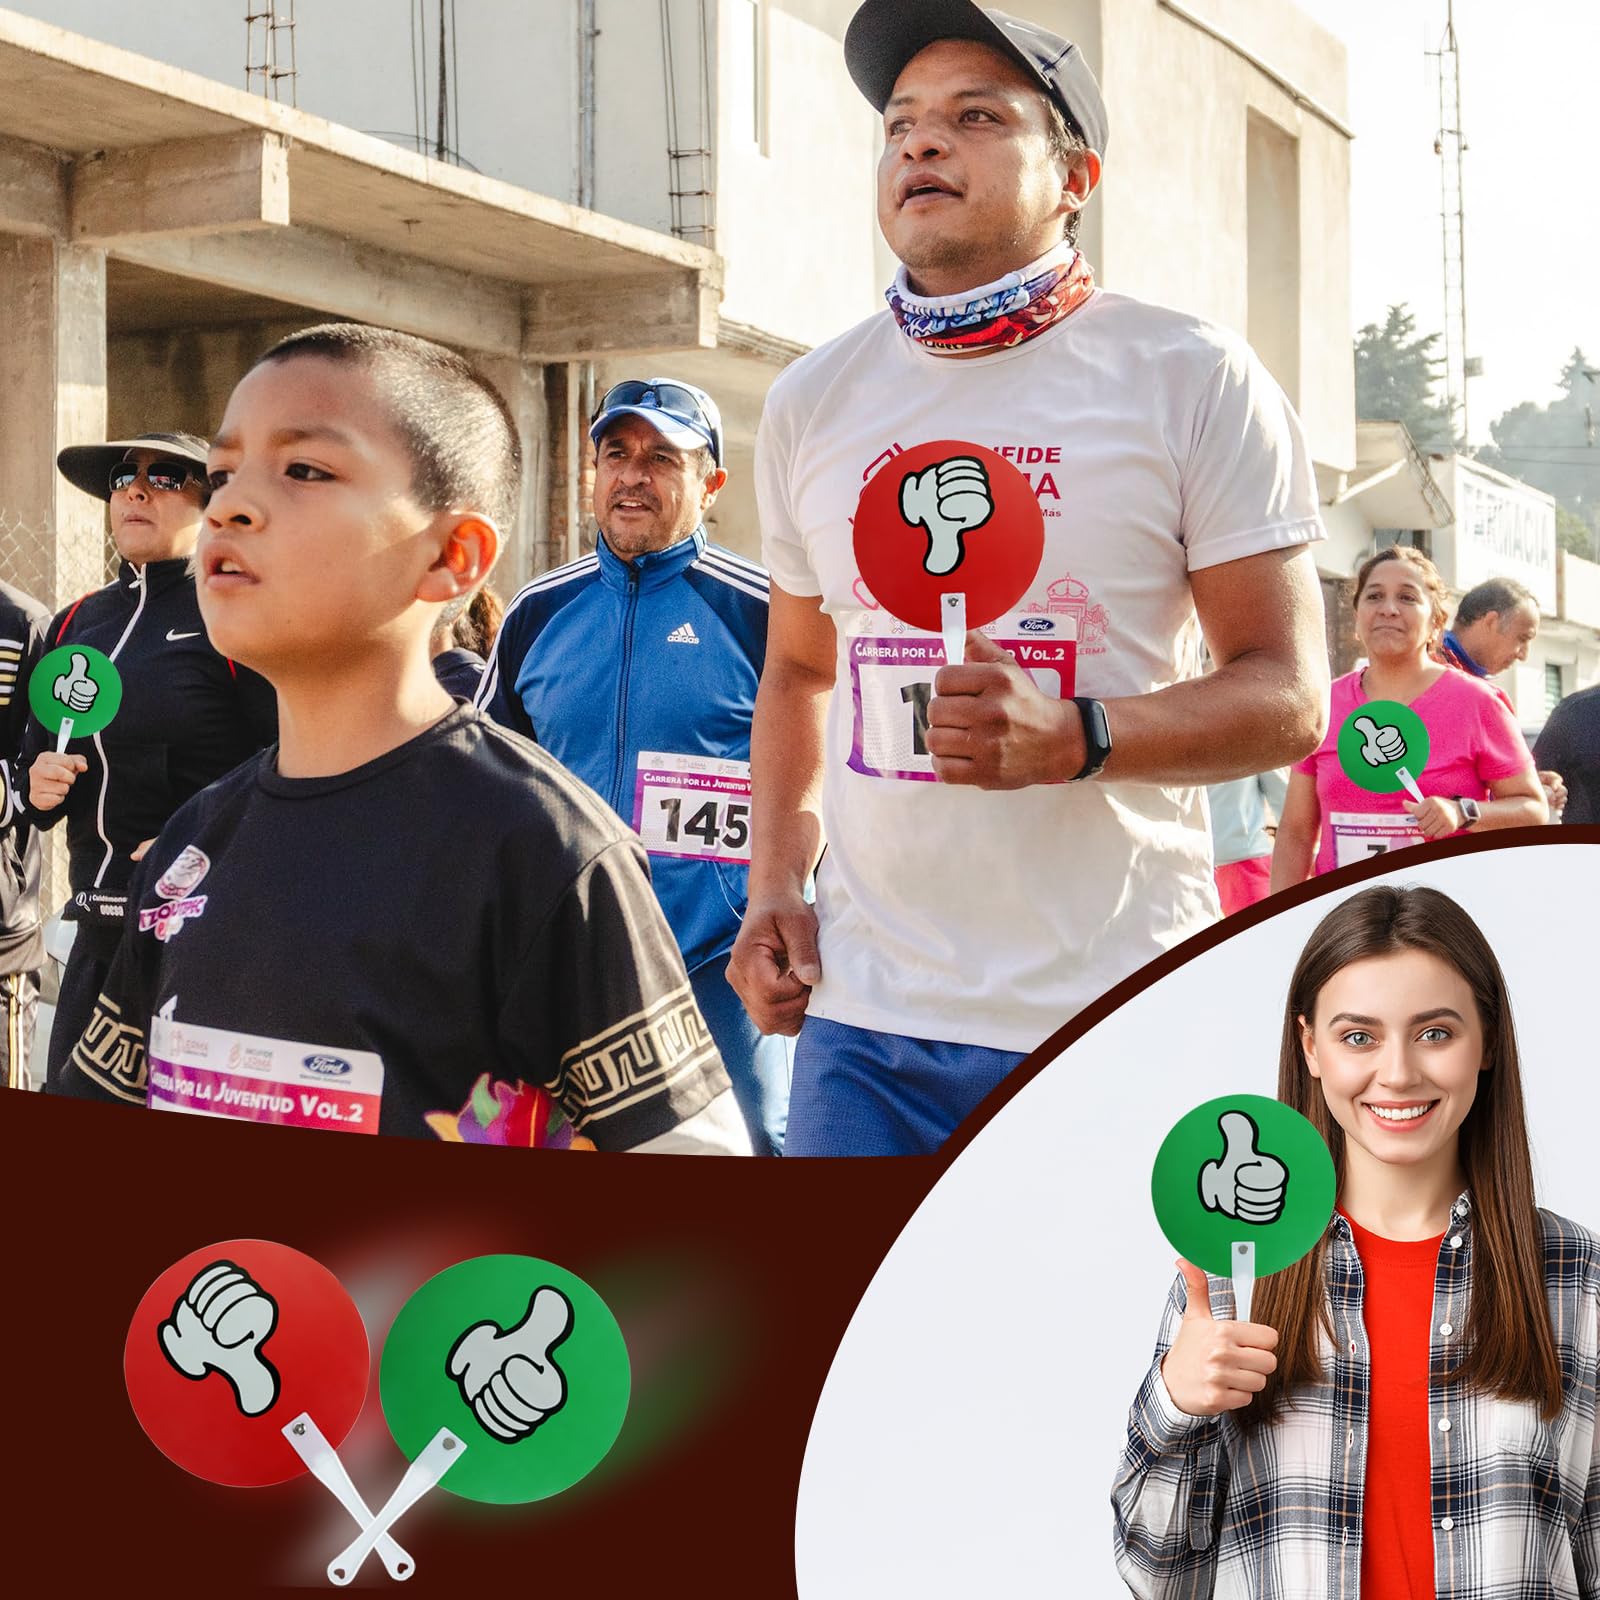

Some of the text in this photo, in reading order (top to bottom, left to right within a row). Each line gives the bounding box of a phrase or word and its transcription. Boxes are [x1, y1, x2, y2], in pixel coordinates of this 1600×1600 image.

[994, 447, 1062, 464] FIDE
[1023, 472, 1061, 500] A
[667, 635, 700, 645] adidas
[855, 642, 899, 658] CARRERA
[901, 647, 926, 659] POR
[928, 647, 945, 659] LA
[1018, 645, 1066, 661] VOL.2
[643, 772, 682, 784] CARRERA
[682, 778, 700, 787] POR
[701, 779, 711, 788] LA
[659, 797, 749, 849] 145
[309, 1056, 344, 1075] Ford
[195, 1082, 212, 1100] LA
[213, 1081, 295, 1114] JUVENTUD
[300, 1094, 364, 1123] VOL.2
